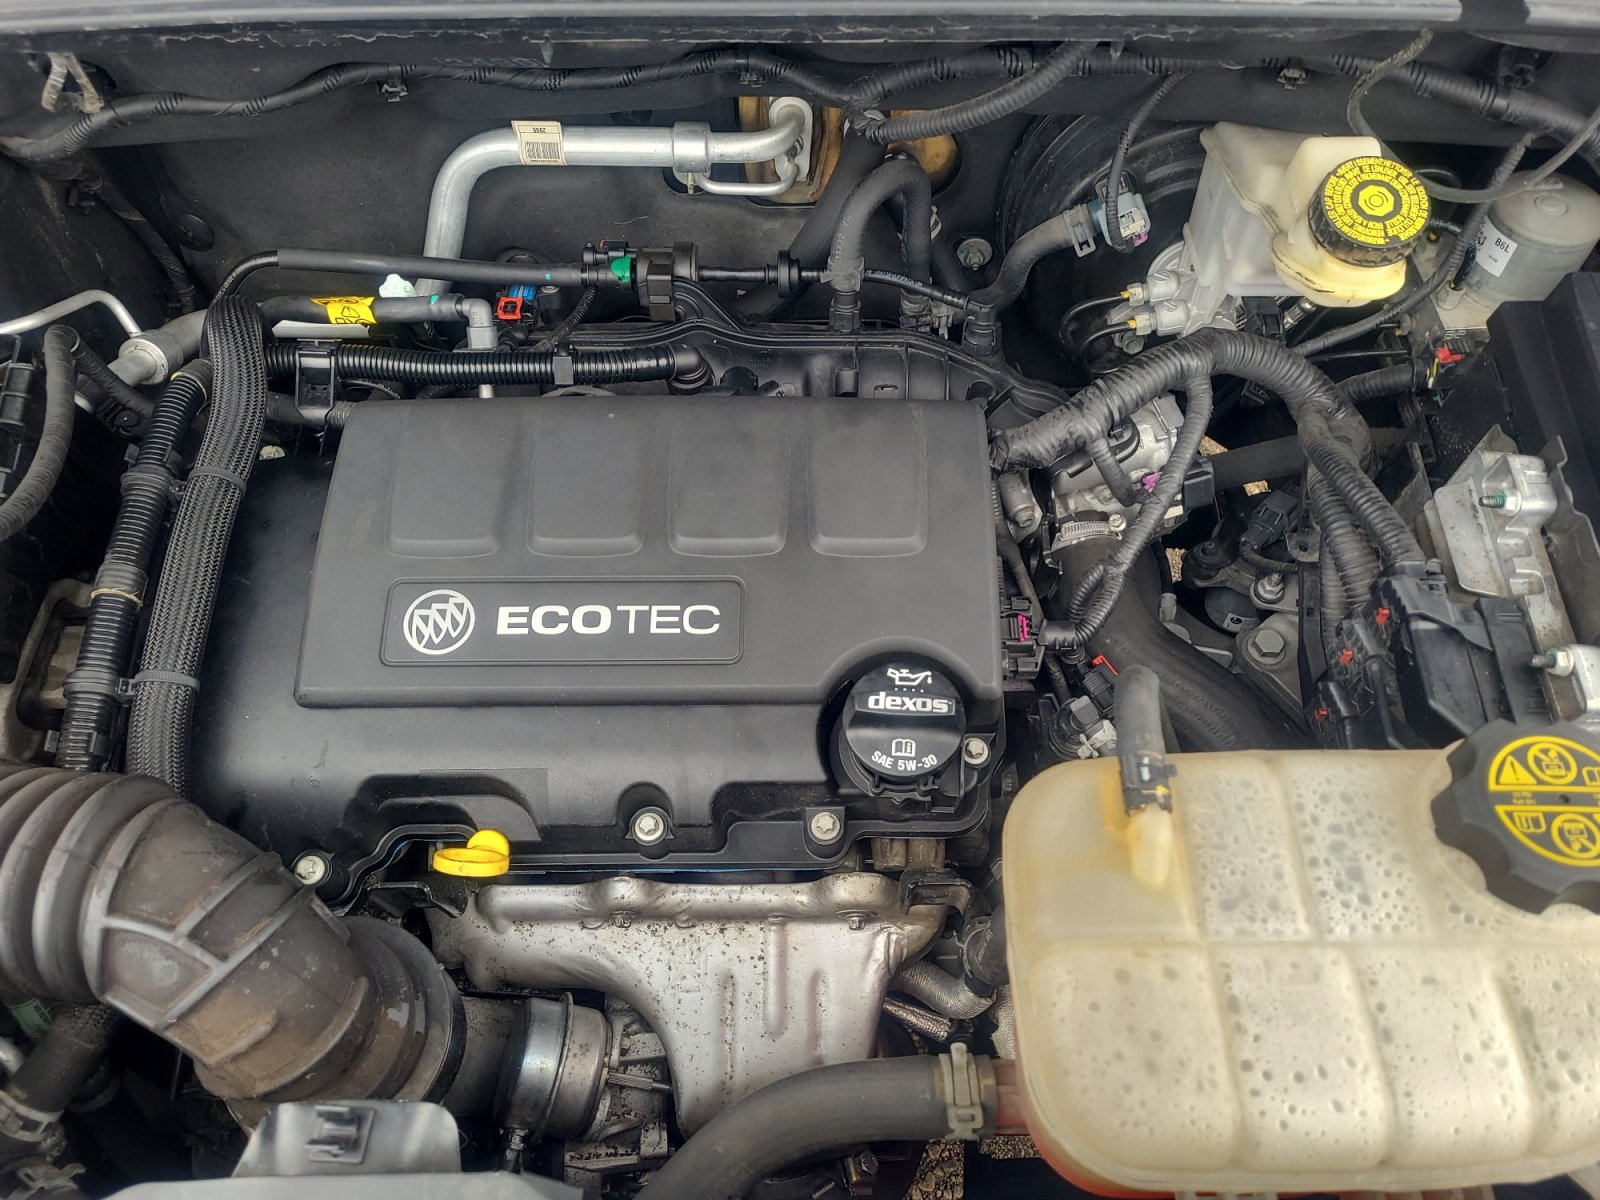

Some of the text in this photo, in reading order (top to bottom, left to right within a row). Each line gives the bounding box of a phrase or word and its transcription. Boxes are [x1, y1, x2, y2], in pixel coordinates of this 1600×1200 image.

[1495, 237, 1510, 253] B6L
[496, 604, 721, 635] ECOTEC
[868, 691, 949, 713] dexos
[871, 750, 938, 772] SAE 5W-30
